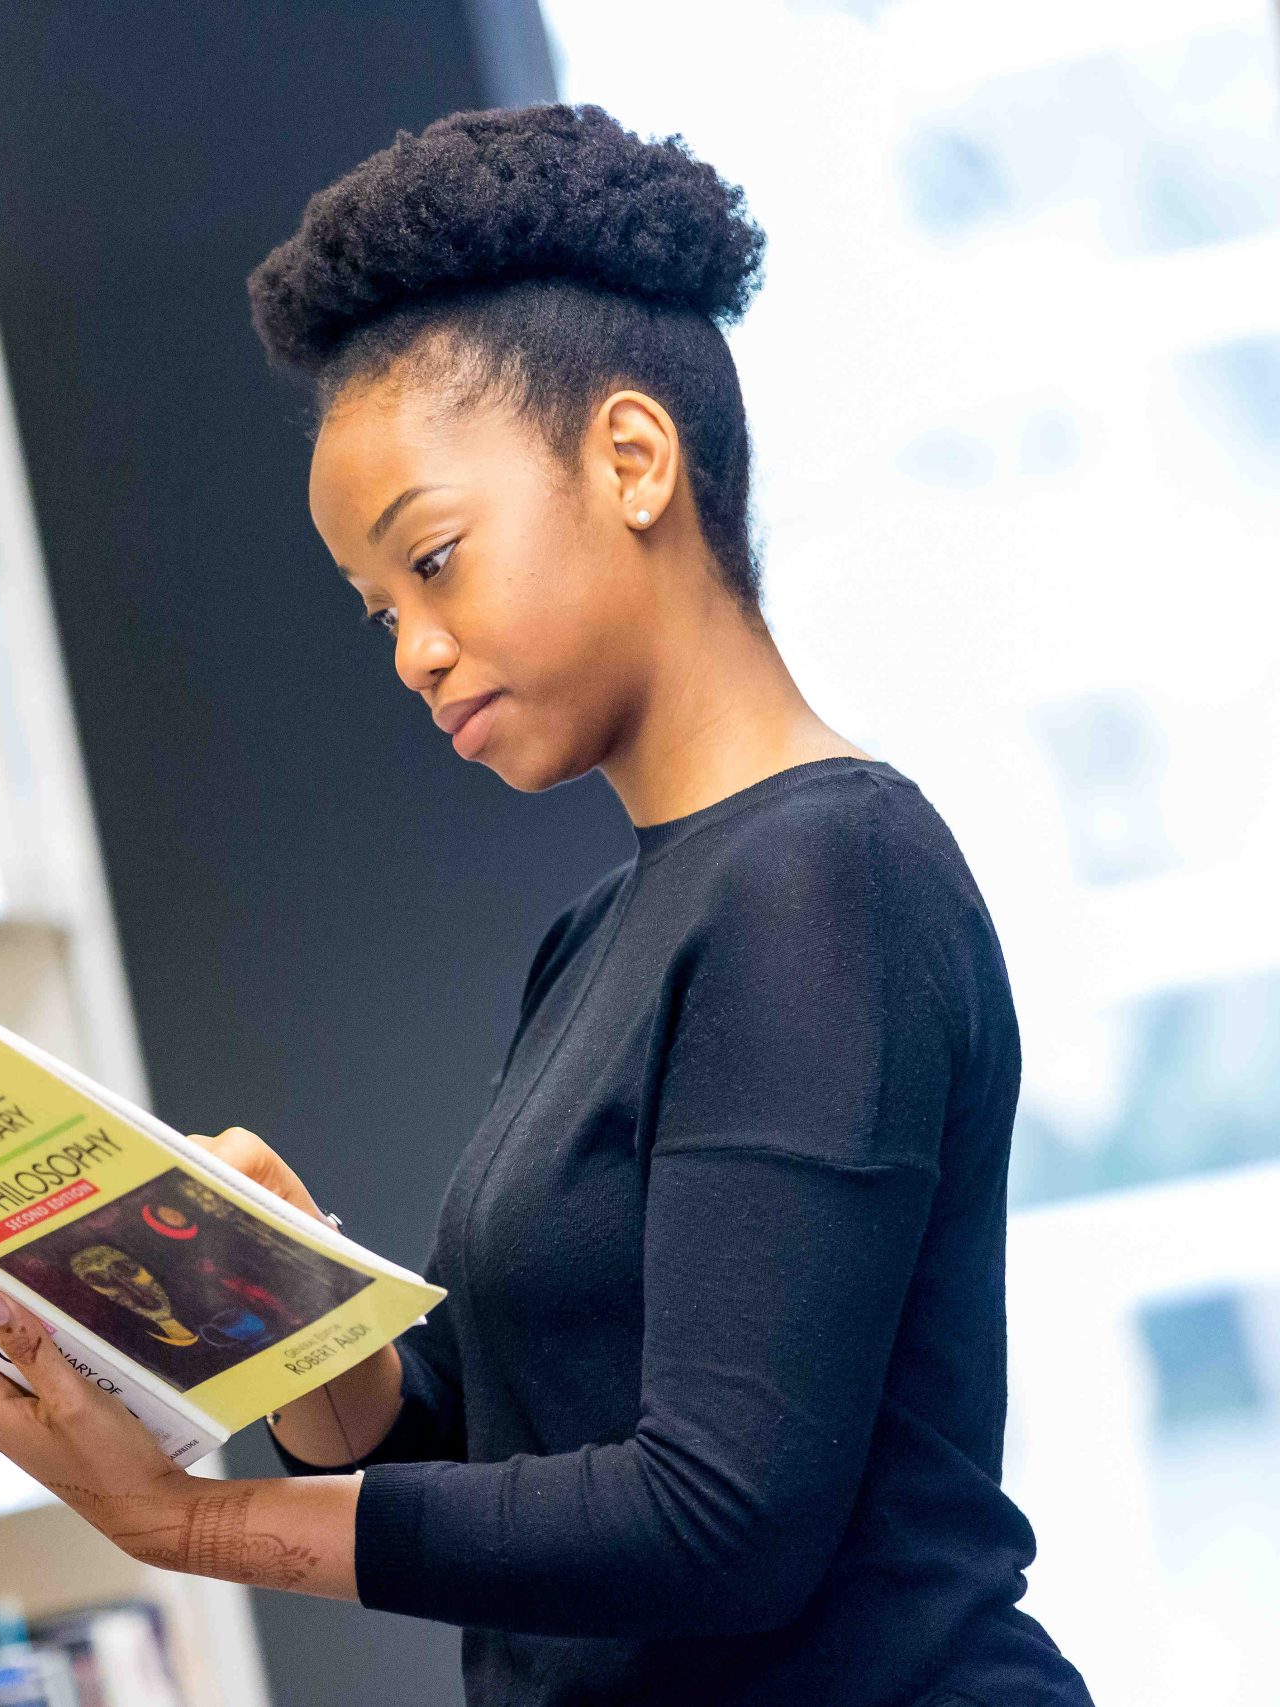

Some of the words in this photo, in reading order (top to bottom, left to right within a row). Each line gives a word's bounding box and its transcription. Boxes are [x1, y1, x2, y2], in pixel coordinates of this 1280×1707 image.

[5, 1202, 49, 1232] SECOND
[48, 1178, 95, 1213] EDITION
[284, 1344, 338, 1376] ROBERT
[332, 1322, 372, 1351] AUDI
[96, 1378, 123, 1395] OF
